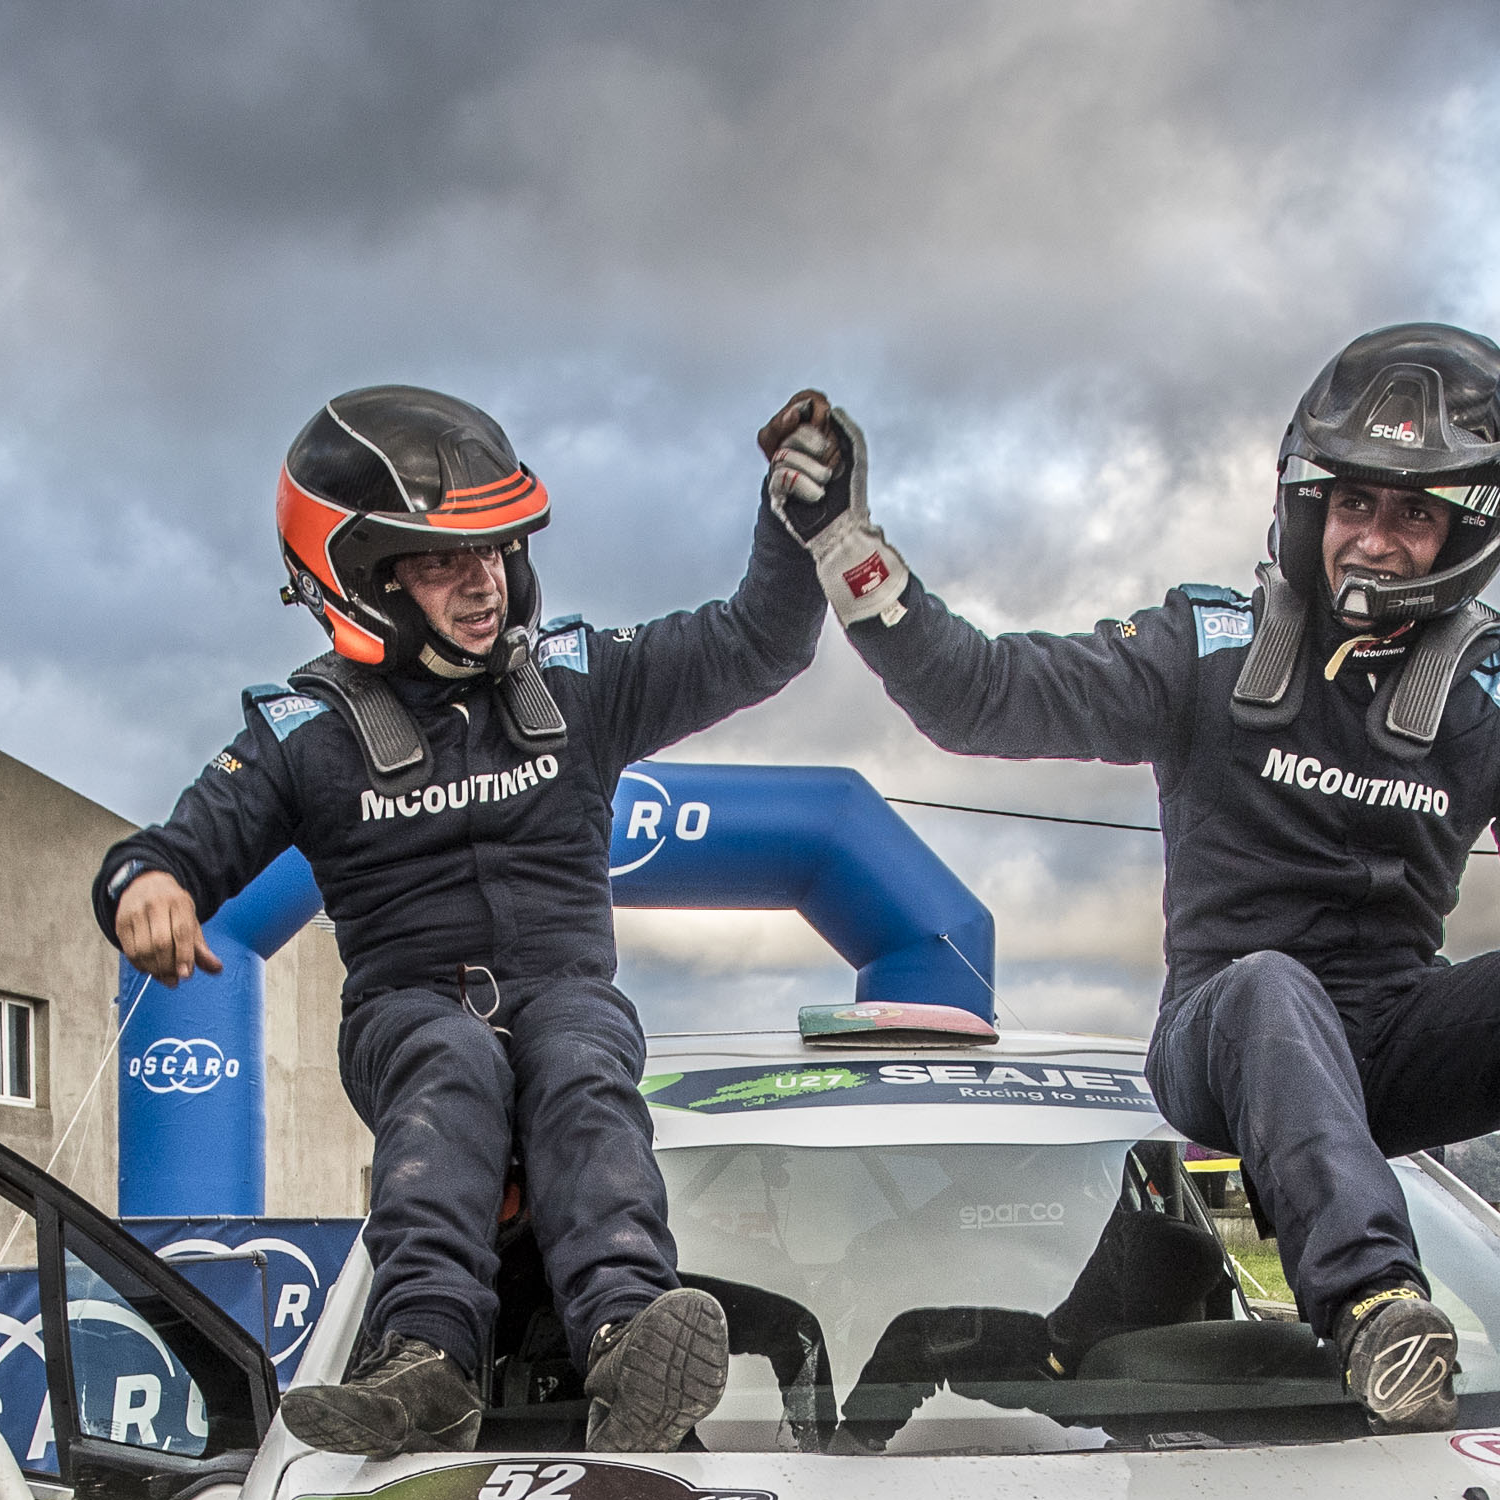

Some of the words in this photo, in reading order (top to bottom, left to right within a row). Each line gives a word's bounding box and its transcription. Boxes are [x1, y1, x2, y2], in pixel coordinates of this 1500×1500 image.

[1203, 616, 1250, 636] OMP
[360, 753, 560, 822] MCOUTINHO
[1261, 746, 1450, 818] MCOUTINHO
[128, 1055, 240, 1078] OSCARO
[776, 1073, 844, 1091] U27
[960, 1085, 1044, 1103] Racing
[1050, 1090, 1077, 1102] to
[960, 1201, 1065, 1229] sparco
